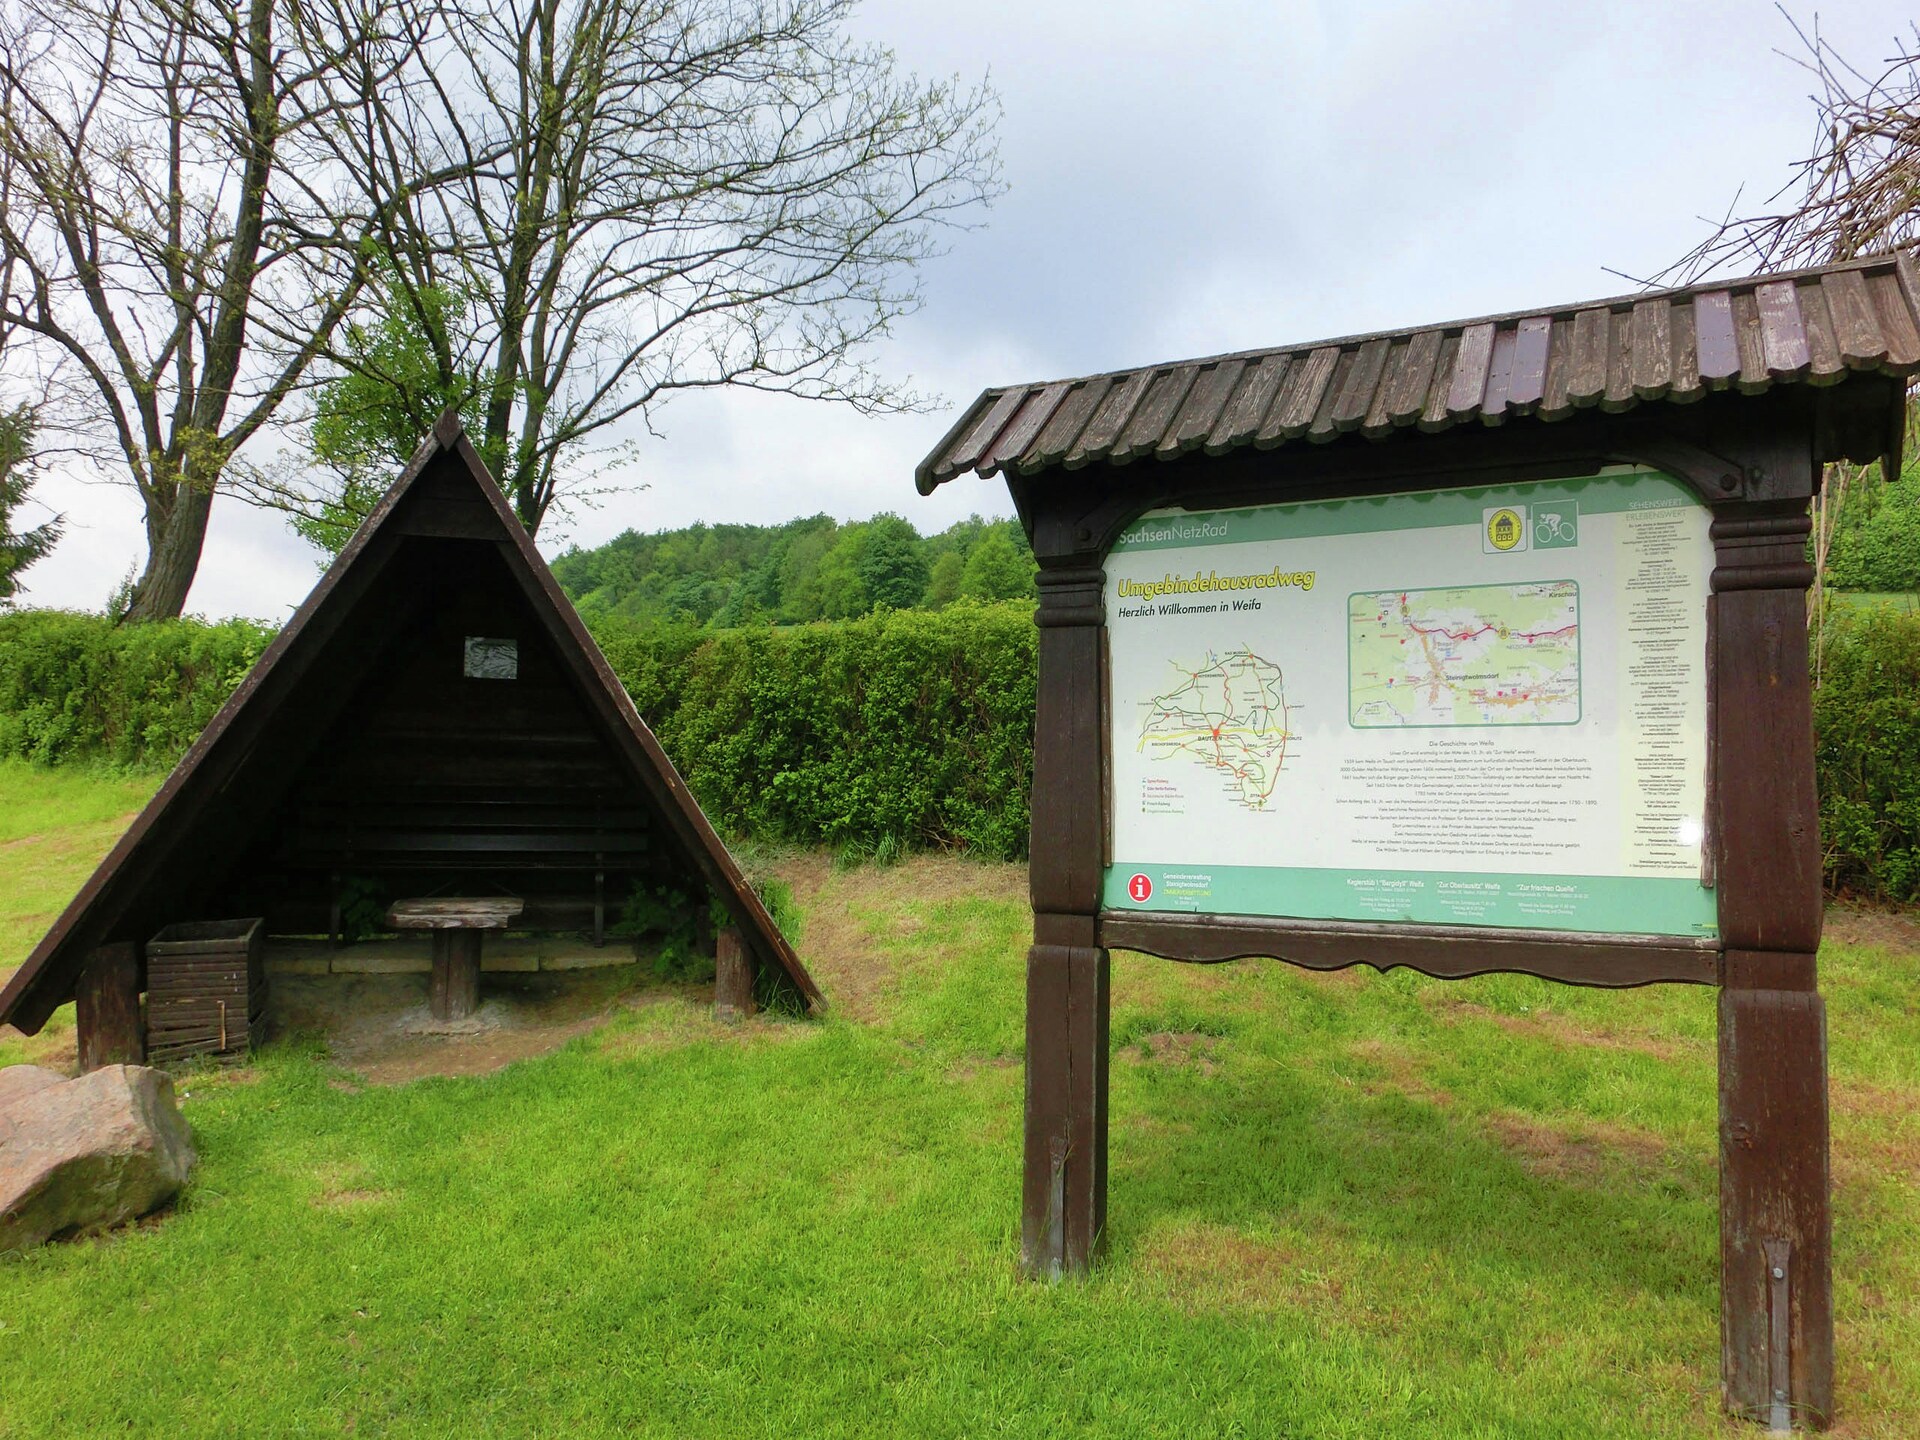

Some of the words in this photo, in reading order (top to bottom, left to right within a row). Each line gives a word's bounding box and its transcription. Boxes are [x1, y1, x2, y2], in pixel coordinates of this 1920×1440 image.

[1629, 498, 1682, 508] SEHENSWERT
[1625, 510, 1687, 521] ERLEBENSWERT
[1119, 521, 1229, 545] SachsenNetzRad
[1117, 565, 1316, 601] Umgebindehausradweg
[1118, 604, 1155, 618] Herzlich
[1158, 602, 1217, 616] Willkommen
[1220, 601, 1229, 612] in
[1232, 598, 1262, 612] Weifa
[1446, 672, 1500, 681] Steinigtwolmsdorf
